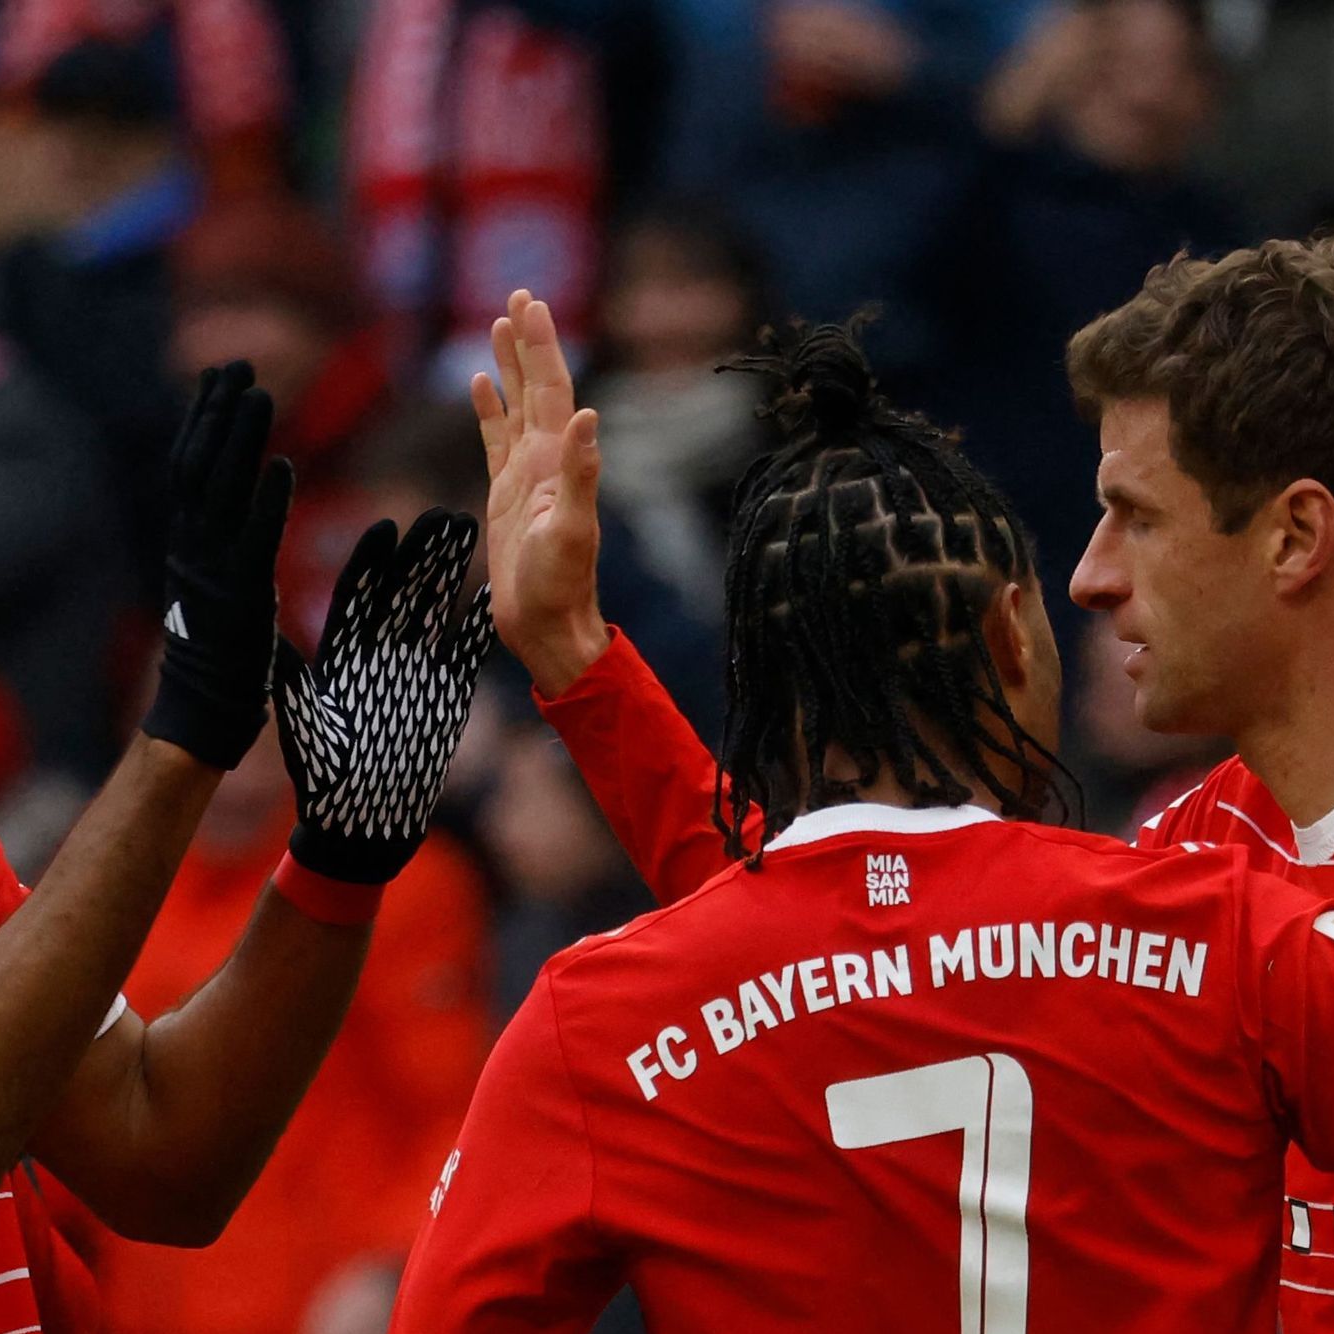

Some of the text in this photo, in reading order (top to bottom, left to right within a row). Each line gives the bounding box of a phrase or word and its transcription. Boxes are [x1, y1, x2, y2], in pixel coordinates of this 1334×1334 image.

[867, 854, 908, 872] MIA
[866, 872, 909, 889] SAN
[868, 888, 910, 907] MIA
[626, 922, 1207, 1101] FC BAYERN MÜNCHEN
